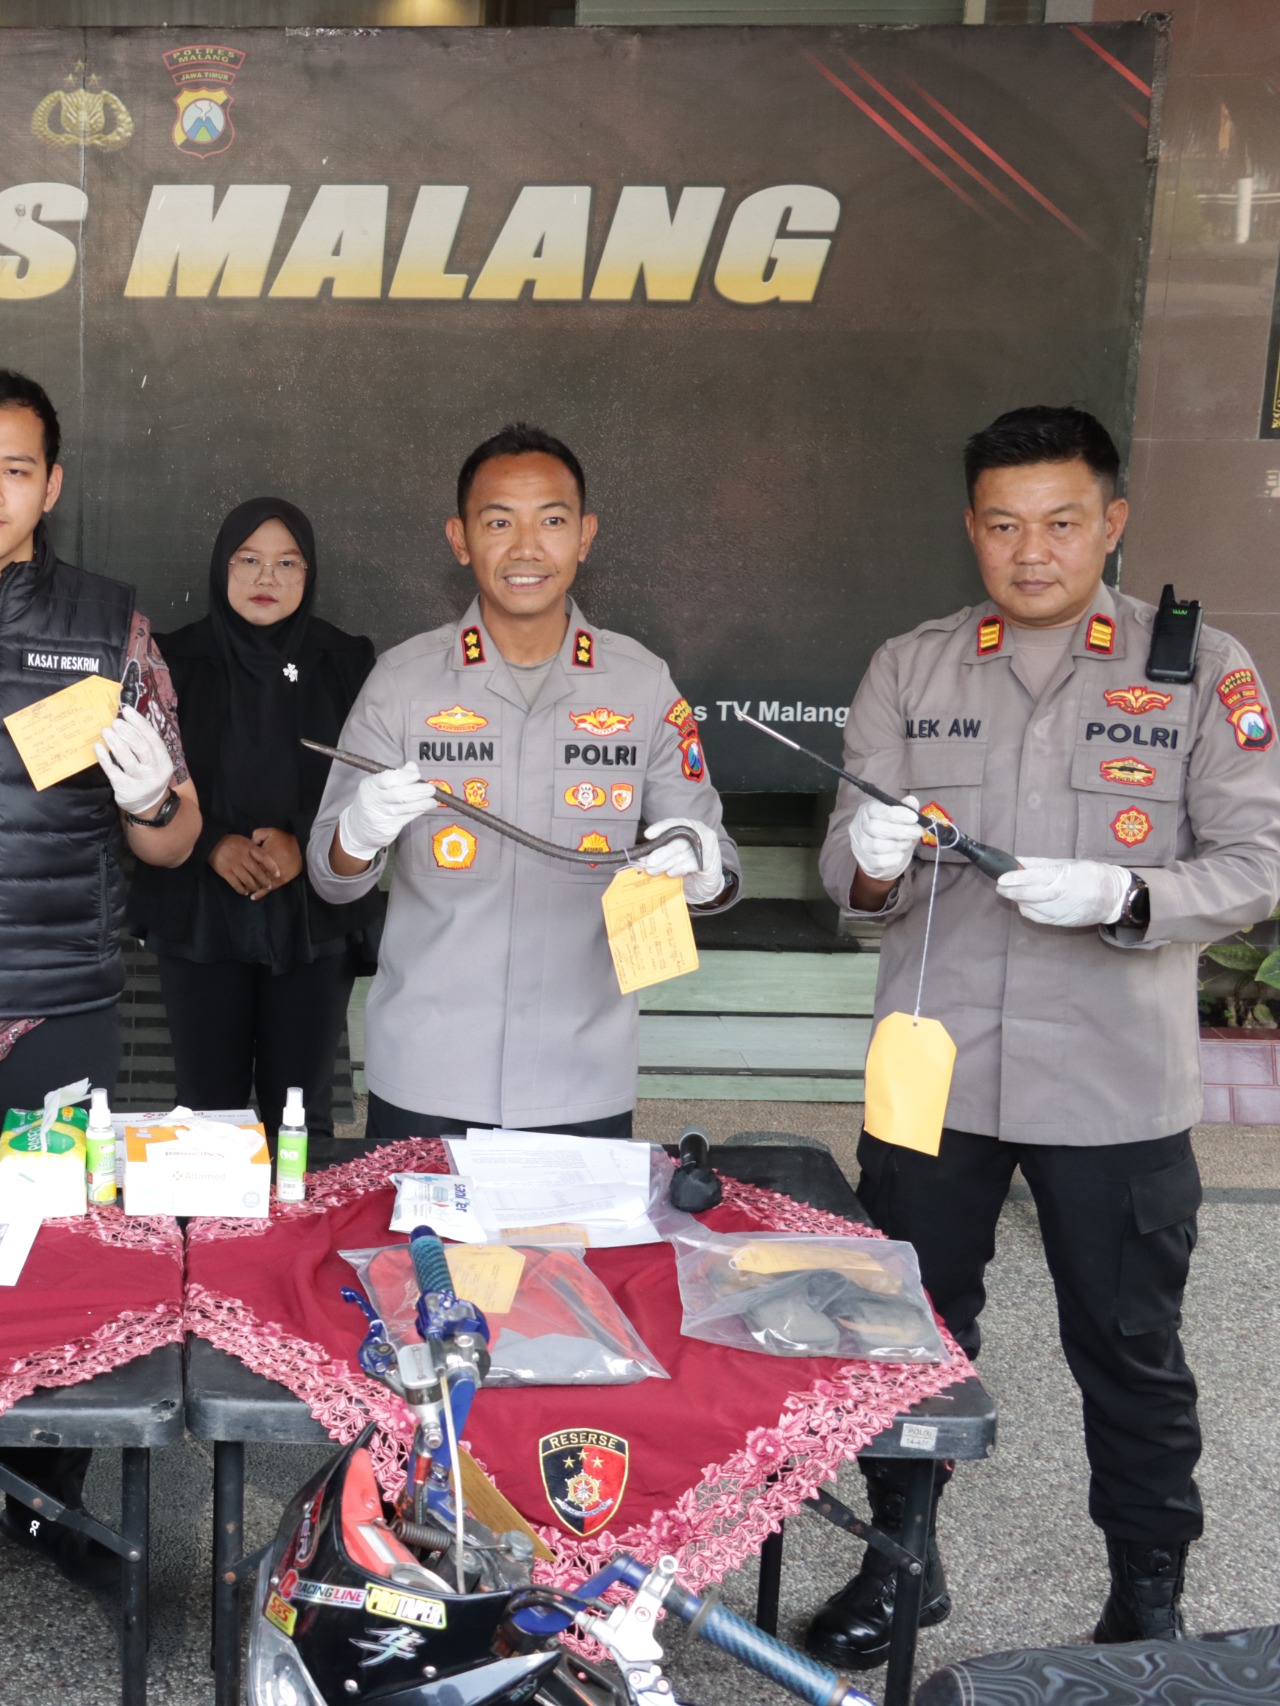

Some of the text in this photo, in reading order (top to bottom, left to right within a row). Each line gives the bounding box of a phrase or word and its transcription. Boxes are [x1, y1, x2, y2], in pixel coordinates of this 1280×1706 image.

[173, 48, 235, 59] POLRES
[178, 54, 229, 63] MALANG
[181, 72, 229, 81] JAWA TIMUR
[123, 183, 842, 305] MALANG
[27, 652, 100, 674] KASAT RESKRIM
[716, 701, 751, 722] TV
[758, 701, 851, 728] Malang
[947, 718, 982, 738] AW
[1085, 721, 1179, 750] POLRI
[418, 741, 494, 762] RULIAN
[564, 744, 637, 766] POLRI
[184, 1172, 227, 1182] Altamed
[549, 1432, 619, 1450] RESERSE
